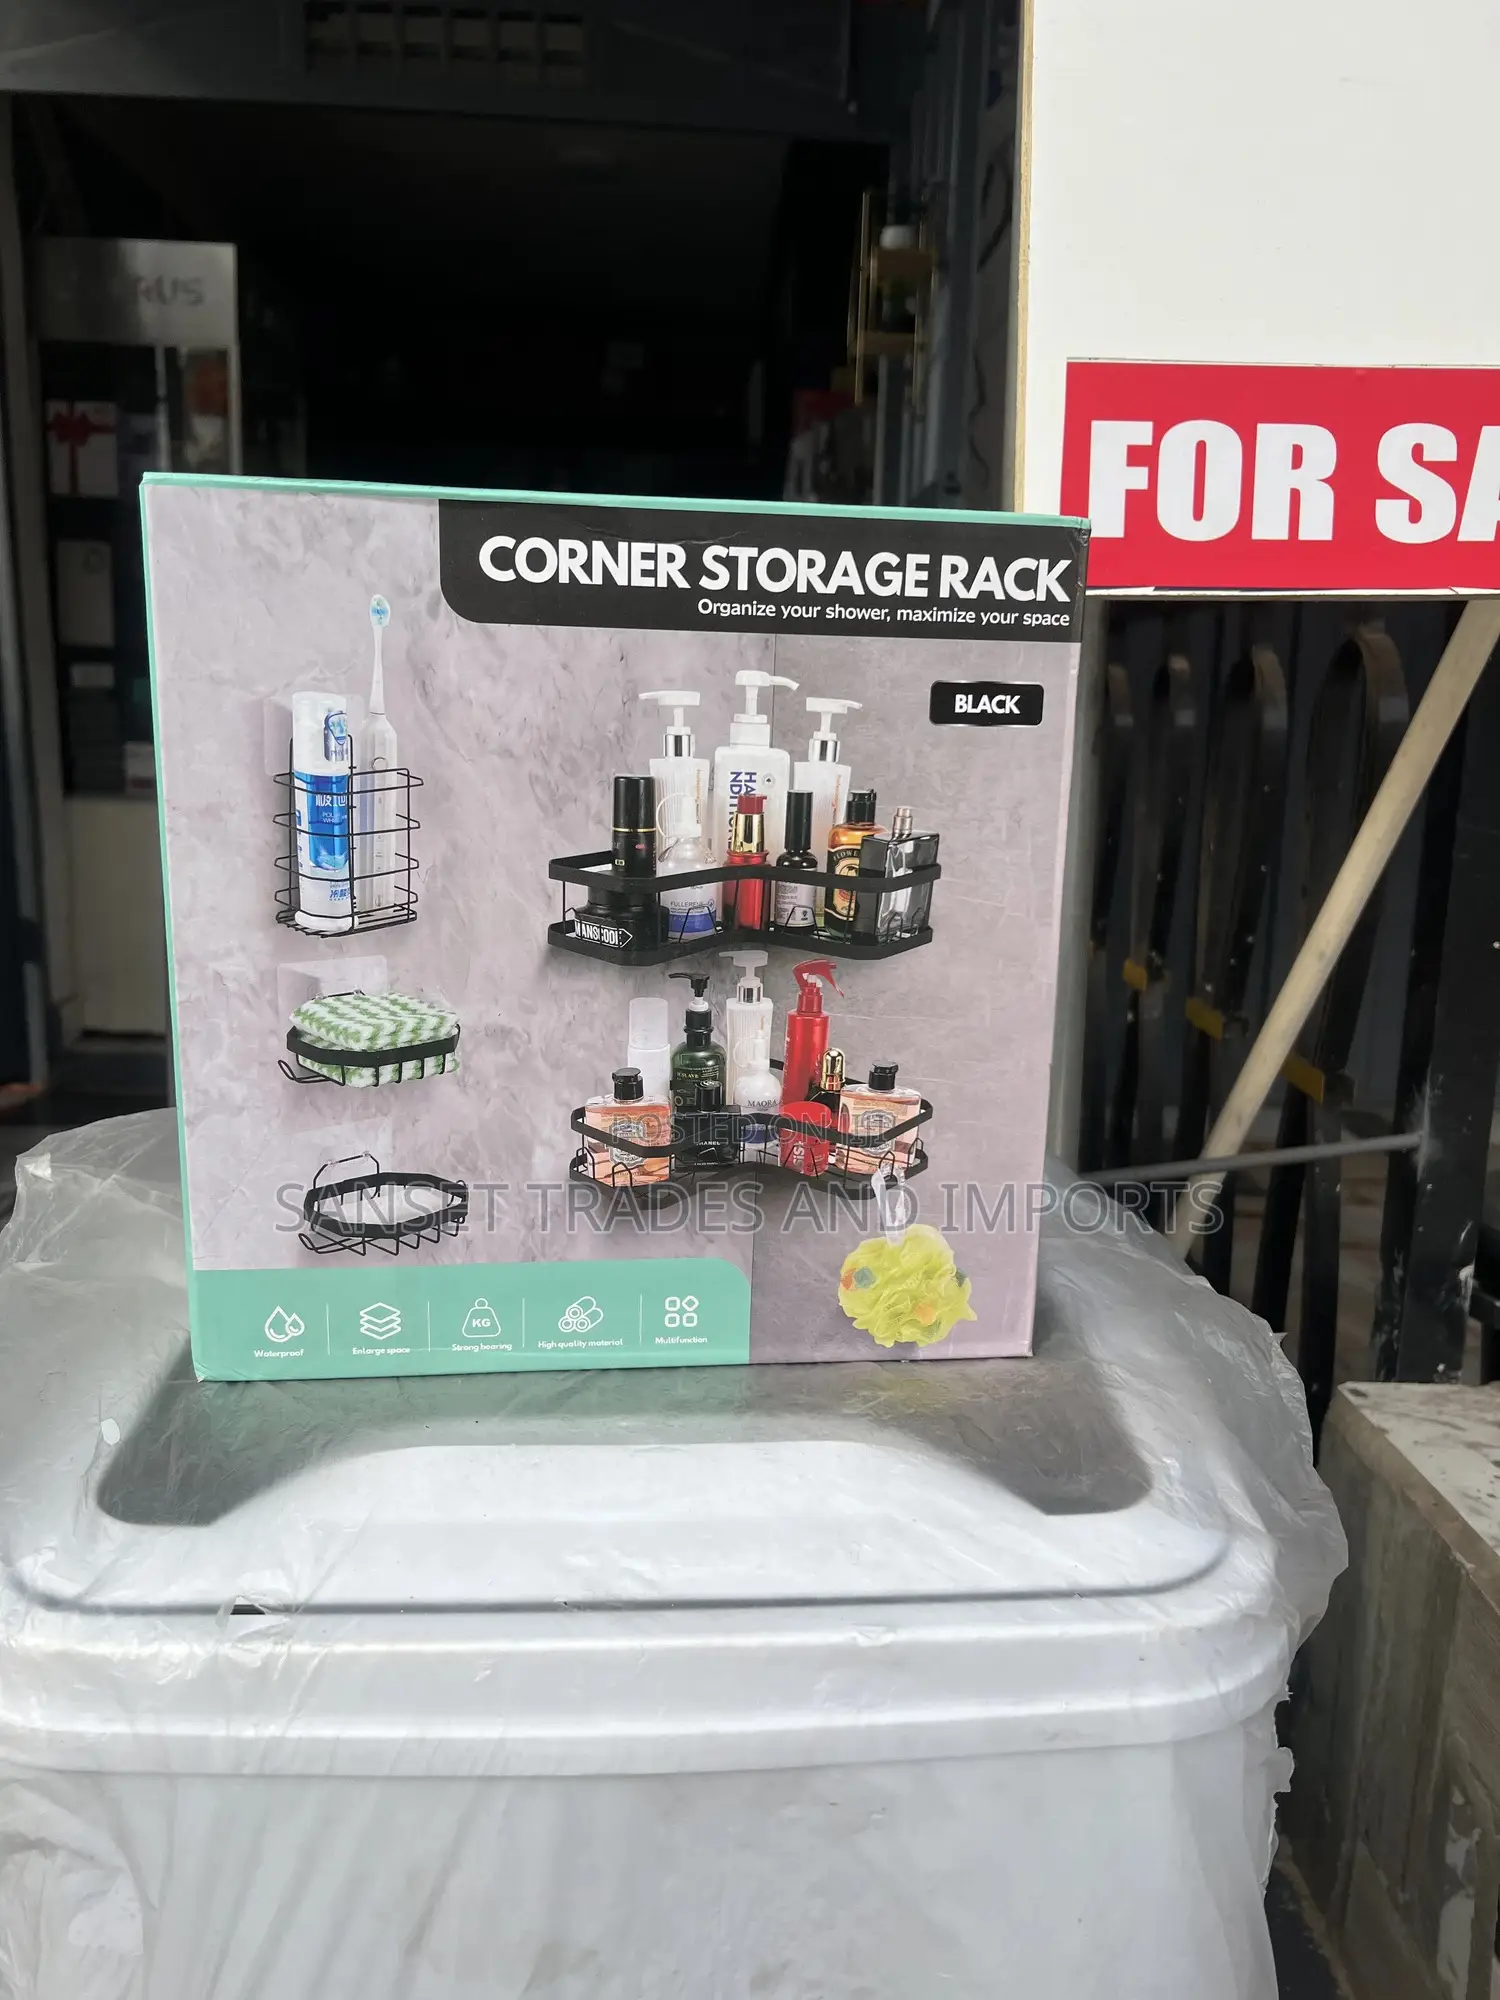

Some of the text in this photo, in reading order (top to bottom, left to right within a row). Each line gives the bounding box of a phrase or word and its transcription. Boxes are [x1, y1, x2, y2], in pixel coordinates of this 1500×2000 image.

[1087, 419, 1338, 542] FOR
[478, 535, 1072, 603] CORNER STORAGE RACK
[697, 598, 1071, 627] Organize your shower, maximize your space
[954, 693, 1021, 714] BLACK
[471, 1318, 492, 1328] KG
[537, 1338, 623, 1350] High quality material
[654, 1335, 708, 1345] Multifunction
[352, 1346, 411, 1356] Enlarge space
[451, 1342, 512, 1352] Strong bearing
[253, 1348, 305, 1358] Waterproof
